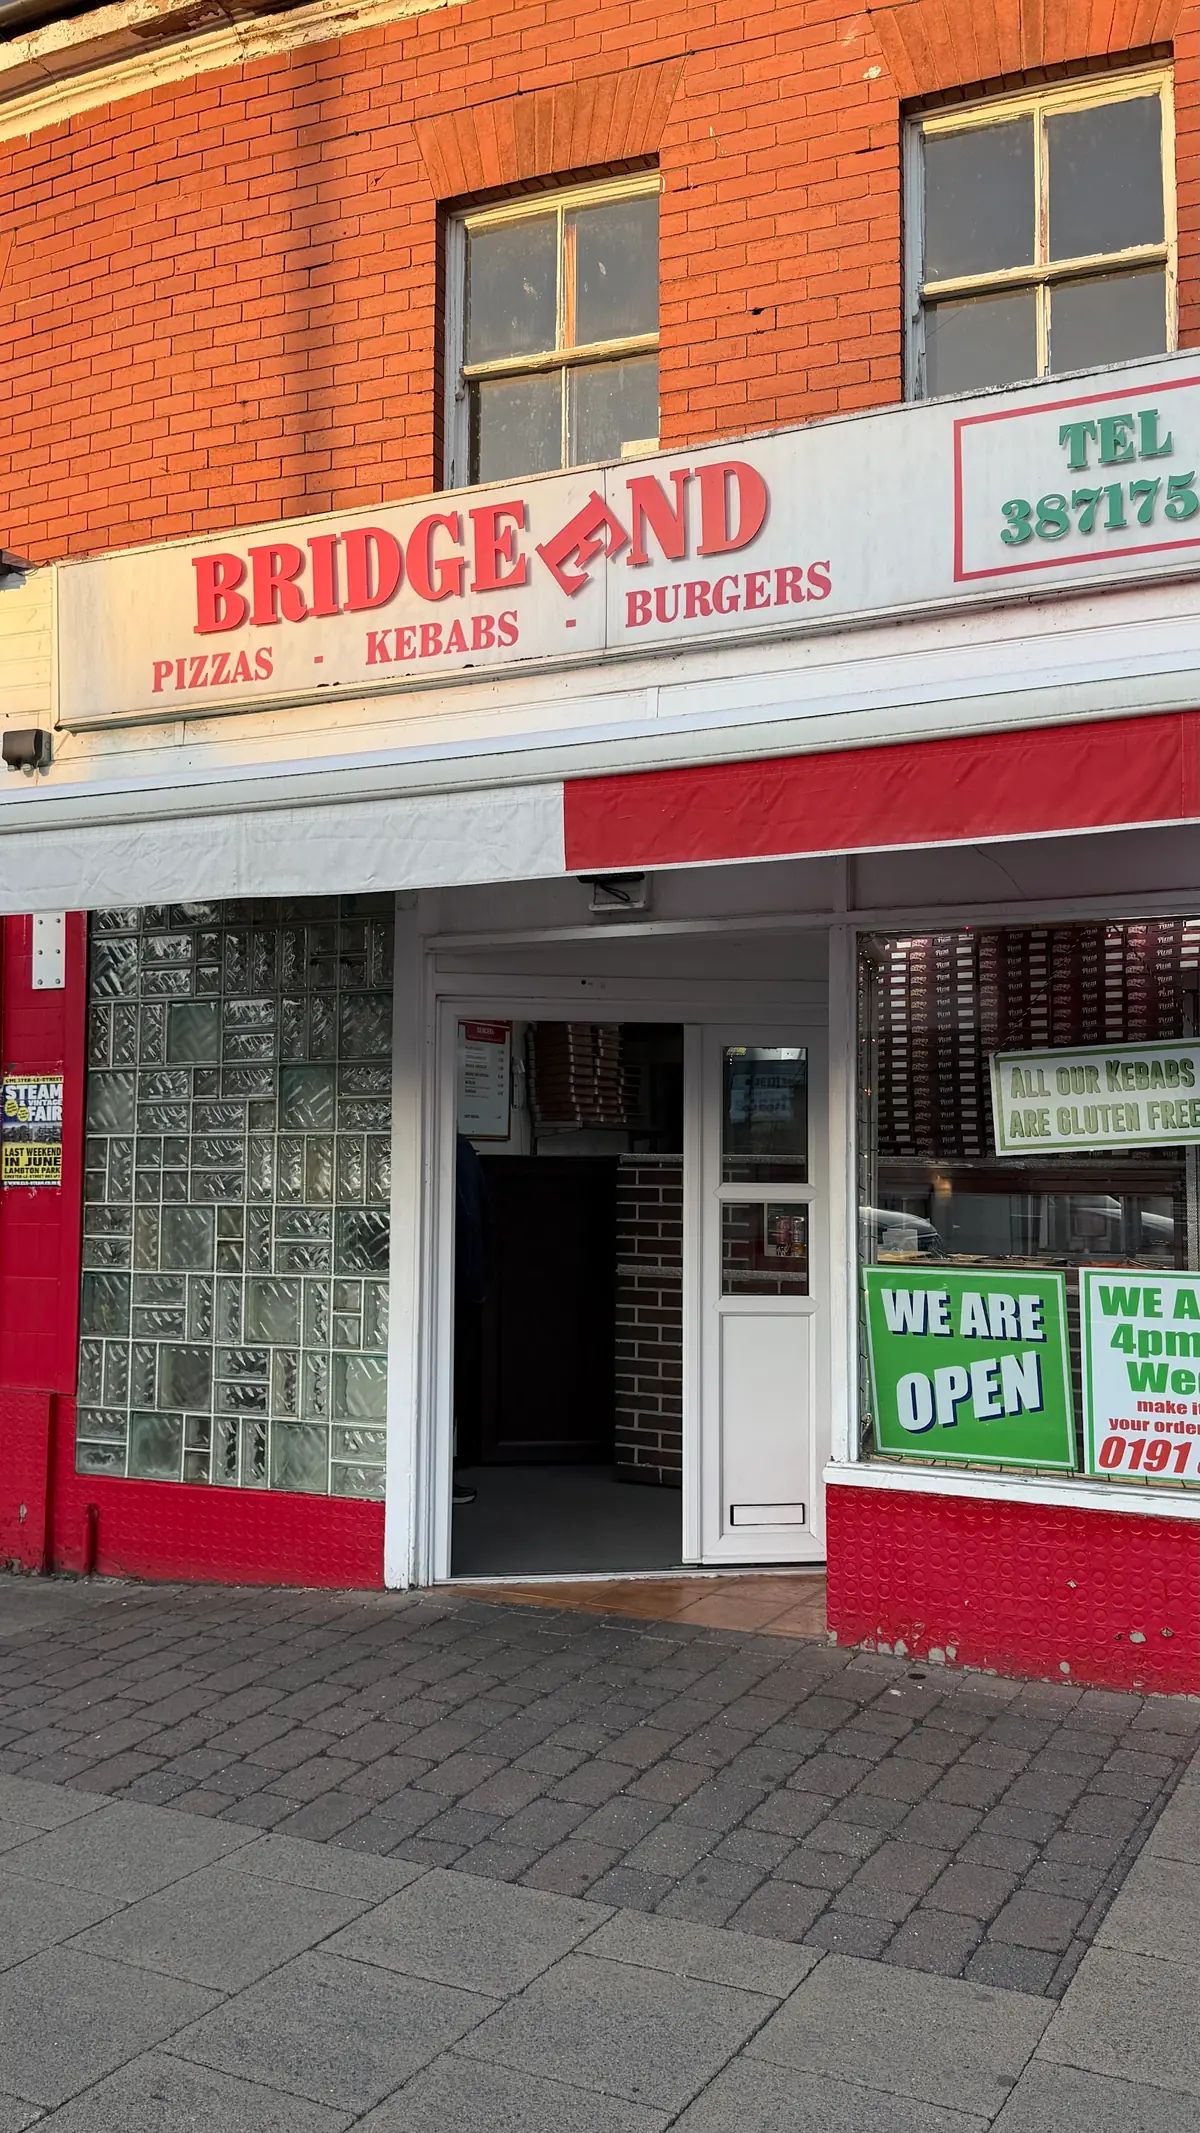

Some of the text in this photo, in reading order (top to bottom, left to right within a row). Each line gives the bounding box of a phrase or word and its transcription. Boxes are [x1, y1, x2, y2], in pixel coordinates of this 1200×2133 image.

[1059, 408, 1172, 469] TEL
[1000, 471, 1200, 544] 387175
[191, 461, 769, 635] BRIDGE END
[152, 647, 274, 693] PIZZAS
[365, 611, 519, 666] KEBABS
[626, 561, 832, 628] BURGERS
[5, 1084, 63, 1100] STEAM
[1010, 1058, 1195, 1098] ALL OUR KEBABS
[28, 1106, 63, 1121] FAIR
[1009, 1098, 1200, 1138] ARE GLUTEN FREE
[5, 1147, 61, 1156] LAST WEEKEND
[5, 1157, 61, 1166] IN JUNE
[881, 1288, 1047, 1343] WE ARE
[1098, 1286, 1163, 1318] WE
[1110, 1323, 1200, 1358] 4pm
[896, 1350, 1044, 1434] OPEN
[1126, 1361, 1200, 1395] We
[1109, 1418, 1149, 1431] your
[1137, 1400, 1188, 1415] make
[1098, 1436, 1192, 1474] 0191
